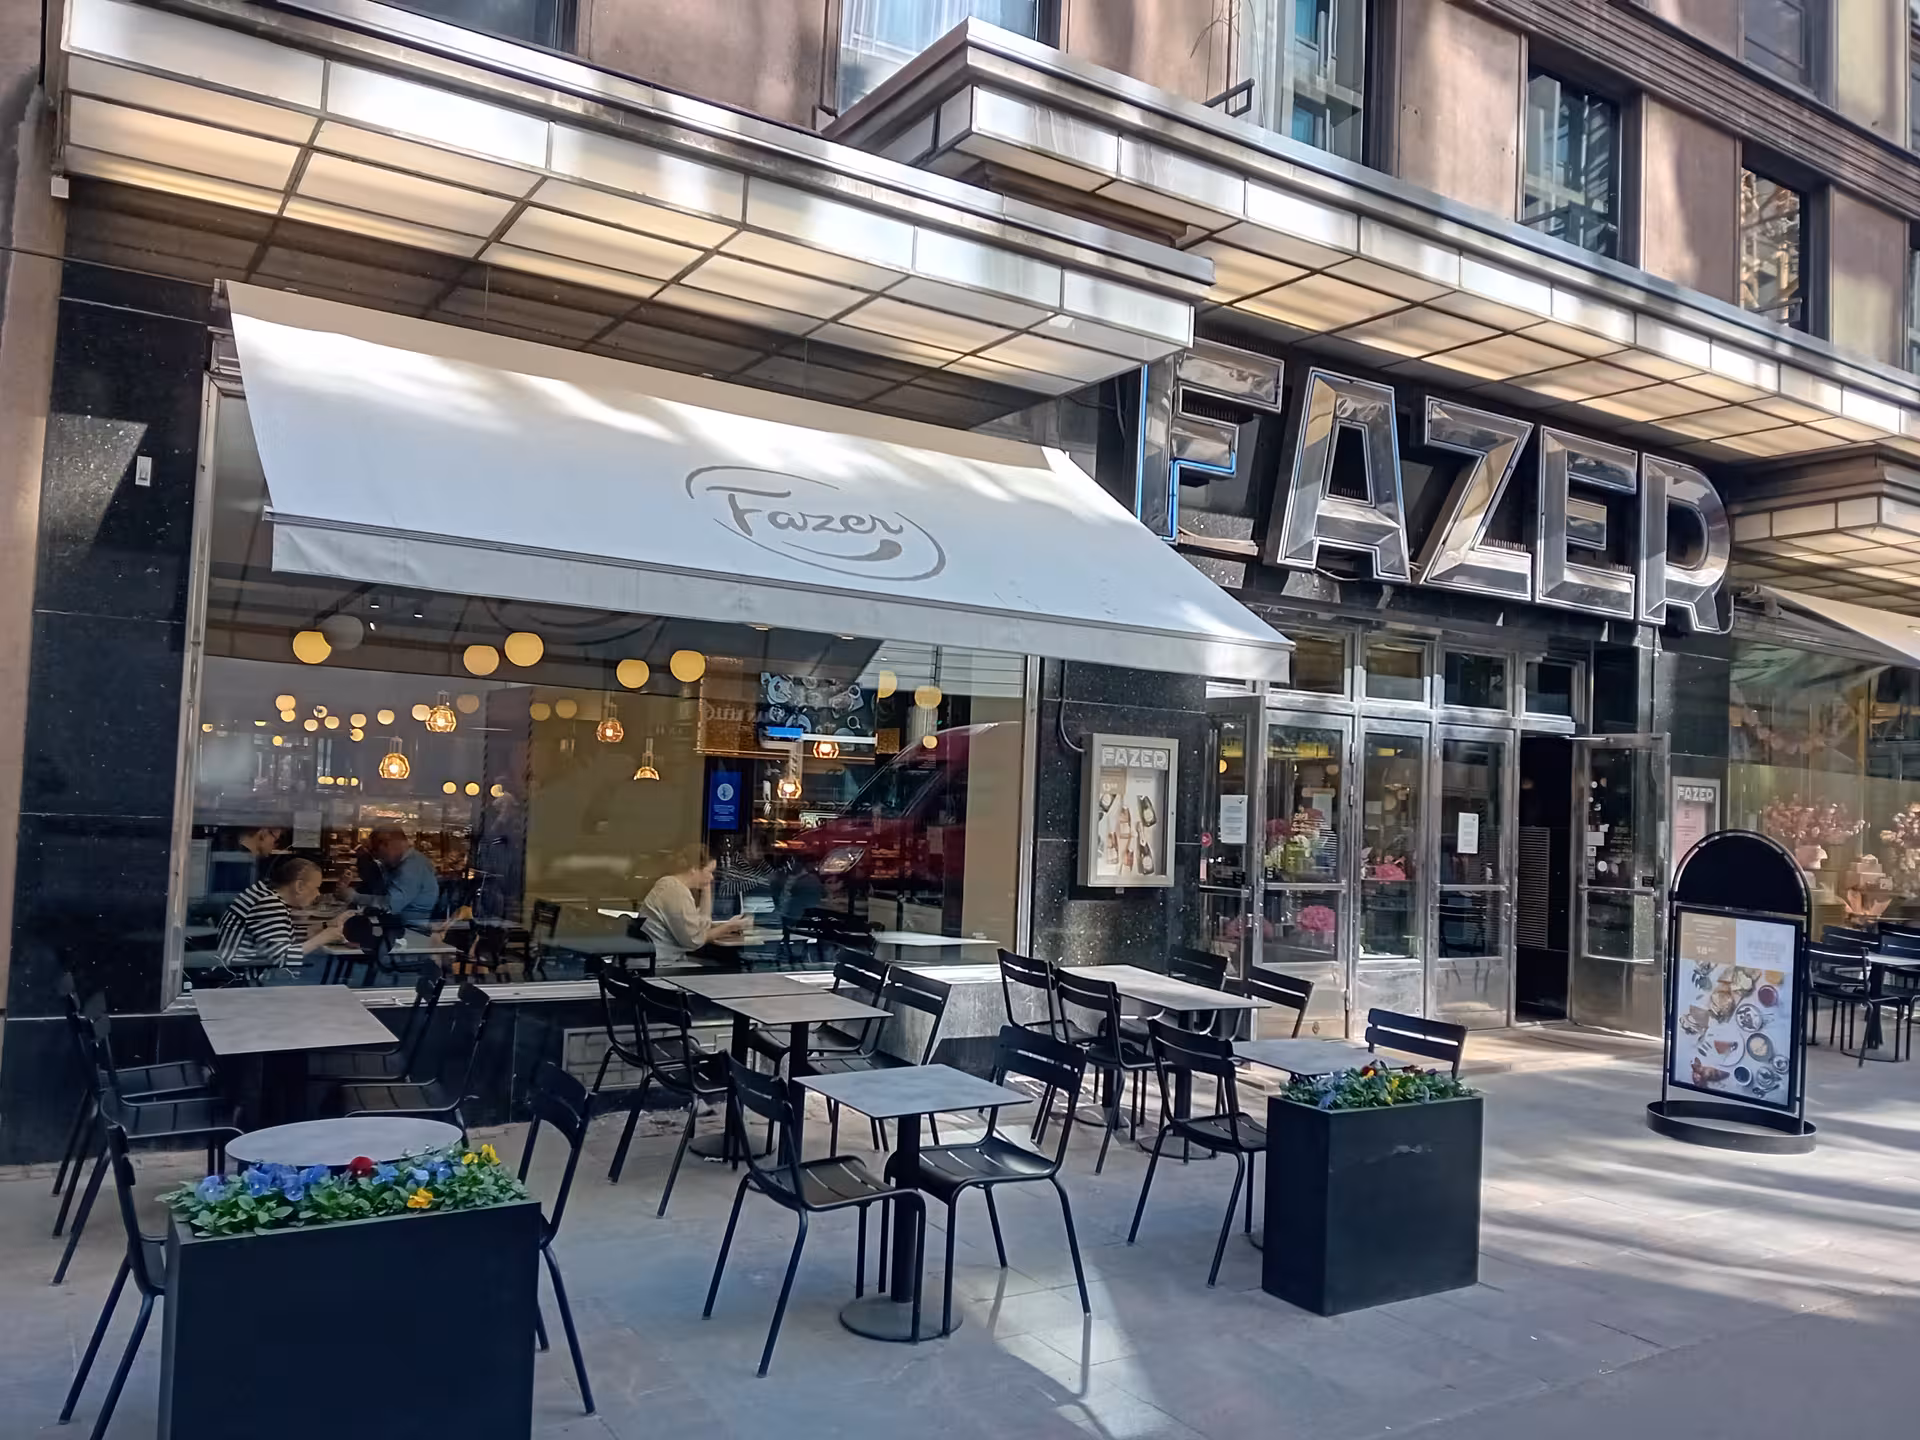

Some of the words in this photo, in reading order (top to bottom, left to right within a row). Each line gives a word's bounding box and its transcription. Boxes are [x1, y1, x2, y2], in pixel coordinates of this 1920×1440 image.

[1136, 338, 1733, 635] FAZER
[706, 485, 904, 537] Fazer
[1102, 747, 1168, 770] FAZER
[1677, 786, 1714, 802] FAZER
